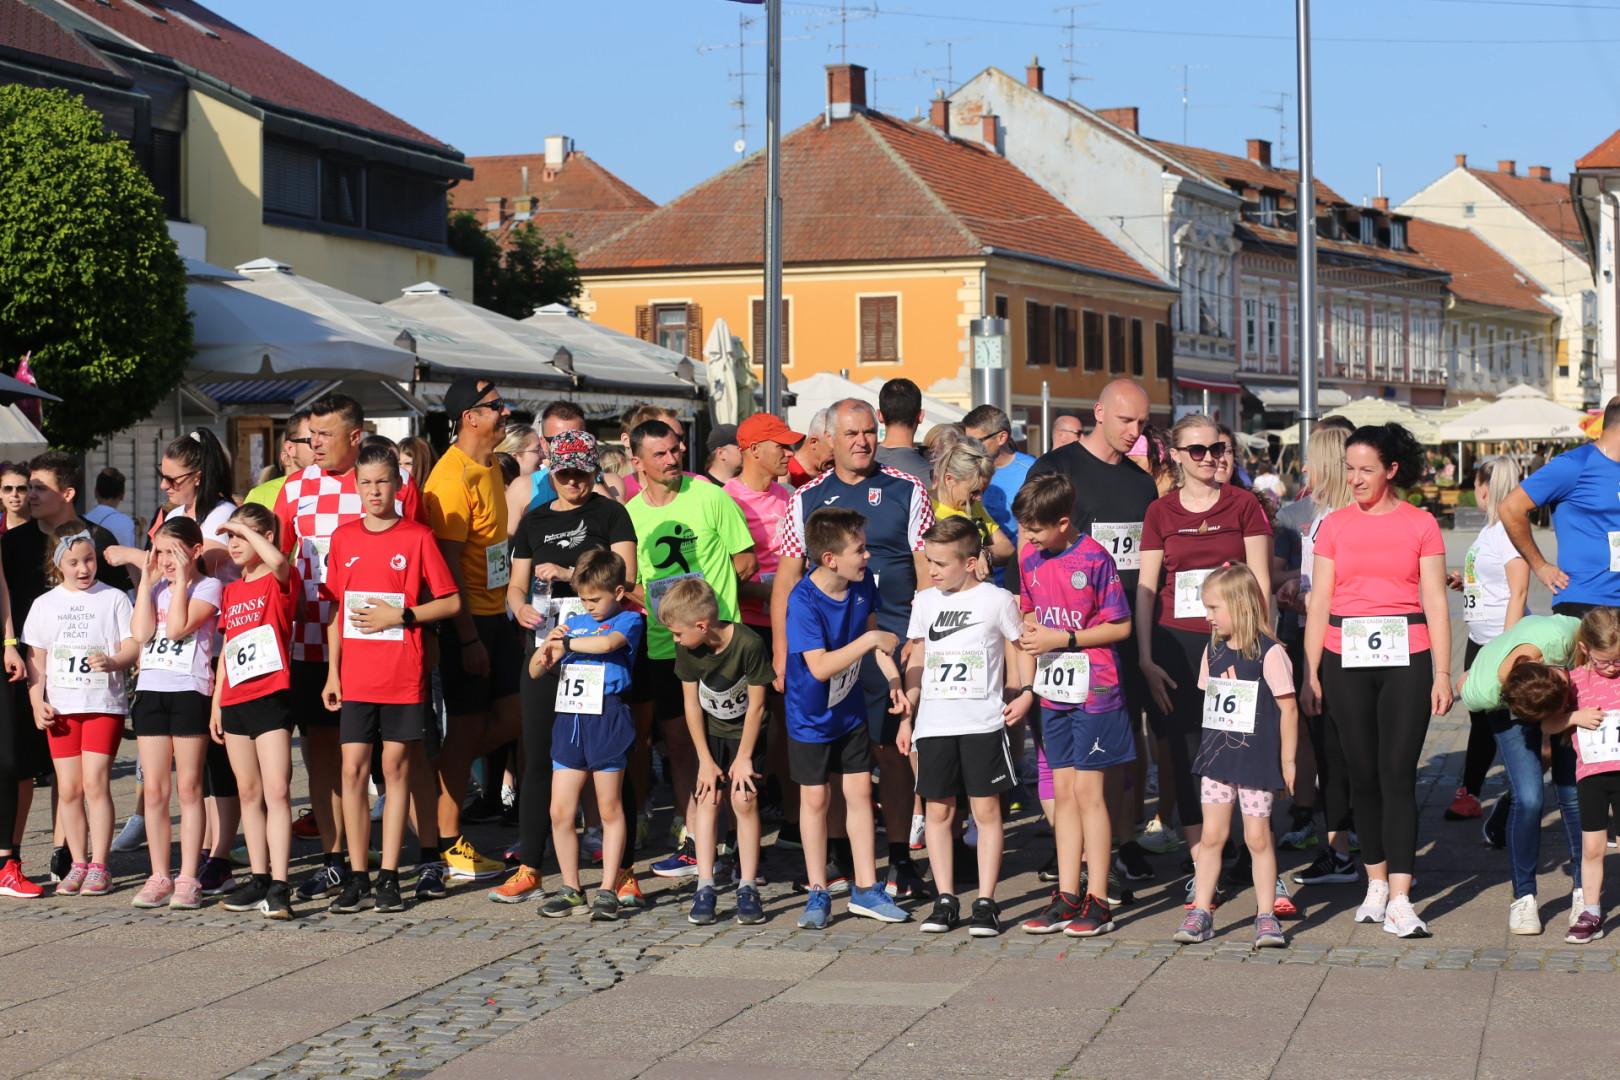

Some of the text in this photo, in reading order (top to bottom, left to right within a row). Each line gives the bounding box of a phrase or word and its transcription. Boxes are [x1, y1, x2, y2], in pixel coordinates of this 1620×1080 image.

[1112, 537, 1133, 554] 19
[57, 613, 96, 621] NARASTEM
[67, 622, 77, 630] JA
[934, 610, 972, 627] NIKE
[63, 630, 88, 639] TRČATI
[1368, 631, 1382, 650] 6
[149, 637, 183, 656] 184
[237, 643, 256, 665] 62
[68, 656, 92, 673] 18
[940, 662, 968, 682] 72
[1043, 667, 1075, 686] 101
[564, 678, 585, 697] 15
[708, 690, 747, 710] 146
[1214, 693, 1236, 714] 16
